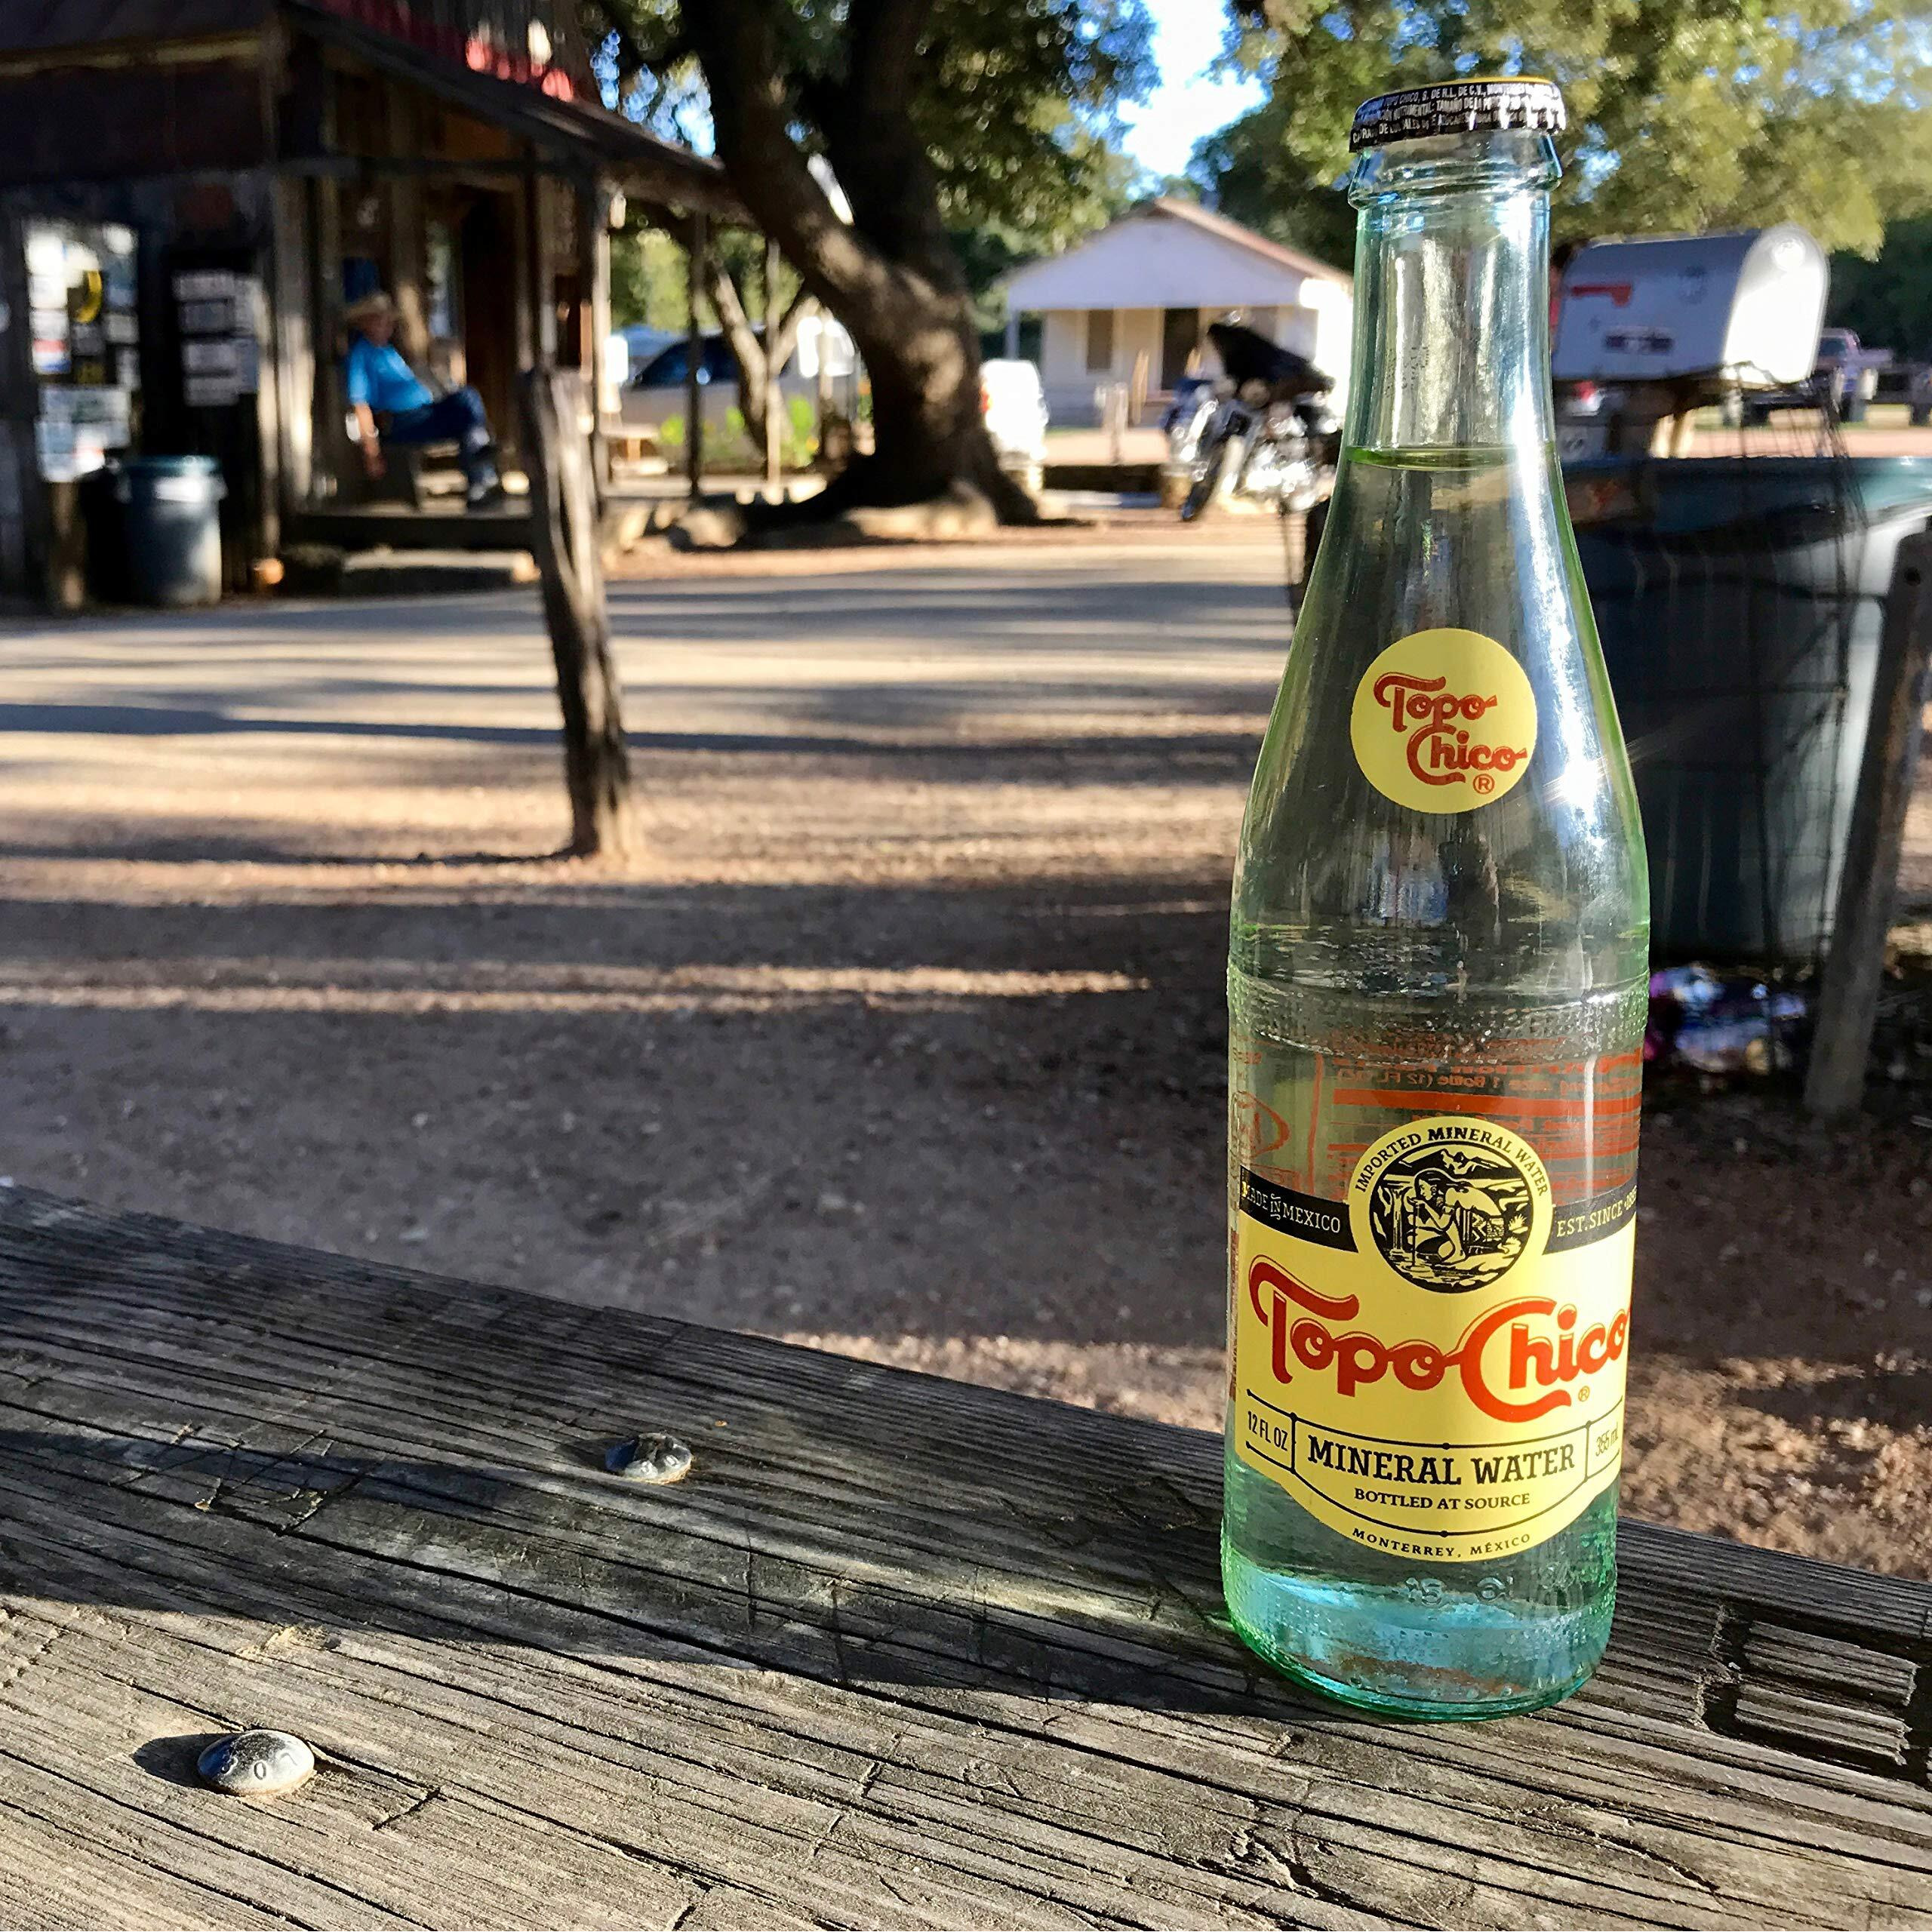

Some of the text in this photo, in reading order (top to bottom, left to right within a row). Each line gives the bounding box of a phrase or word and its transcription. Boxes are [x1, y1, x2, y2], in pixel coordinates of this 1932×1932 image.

[1431, 88, 1440, 99] DE
[1458, 85, 1467, 96] DE
[1464, 97, 1474, 109] DE
[1374, 672, 1497, 732] Topo
[1407, 724, 1527, 786] Chico
[1355, 1127, 1549, 1196] IMPORTED MINERAL WATER
[1283, 1202, 1341, 1233] MEXICO
[1589, 1199, 1623, 1230] SINCE
[1249, 1254, 1630, 1423] Topo Chico
[1247, 1411, 1288, 1451] 12 FL OZ
[1595, 1432, 1611, 1457] 355
[1307, 1435, 1576, 1485] MINERAL WATER
[1354, 1487, 1531, 1509] BOTTLED AT SOURCE
[1352, 1527, 1531, 1558] MONTERREY, MÉXICO
